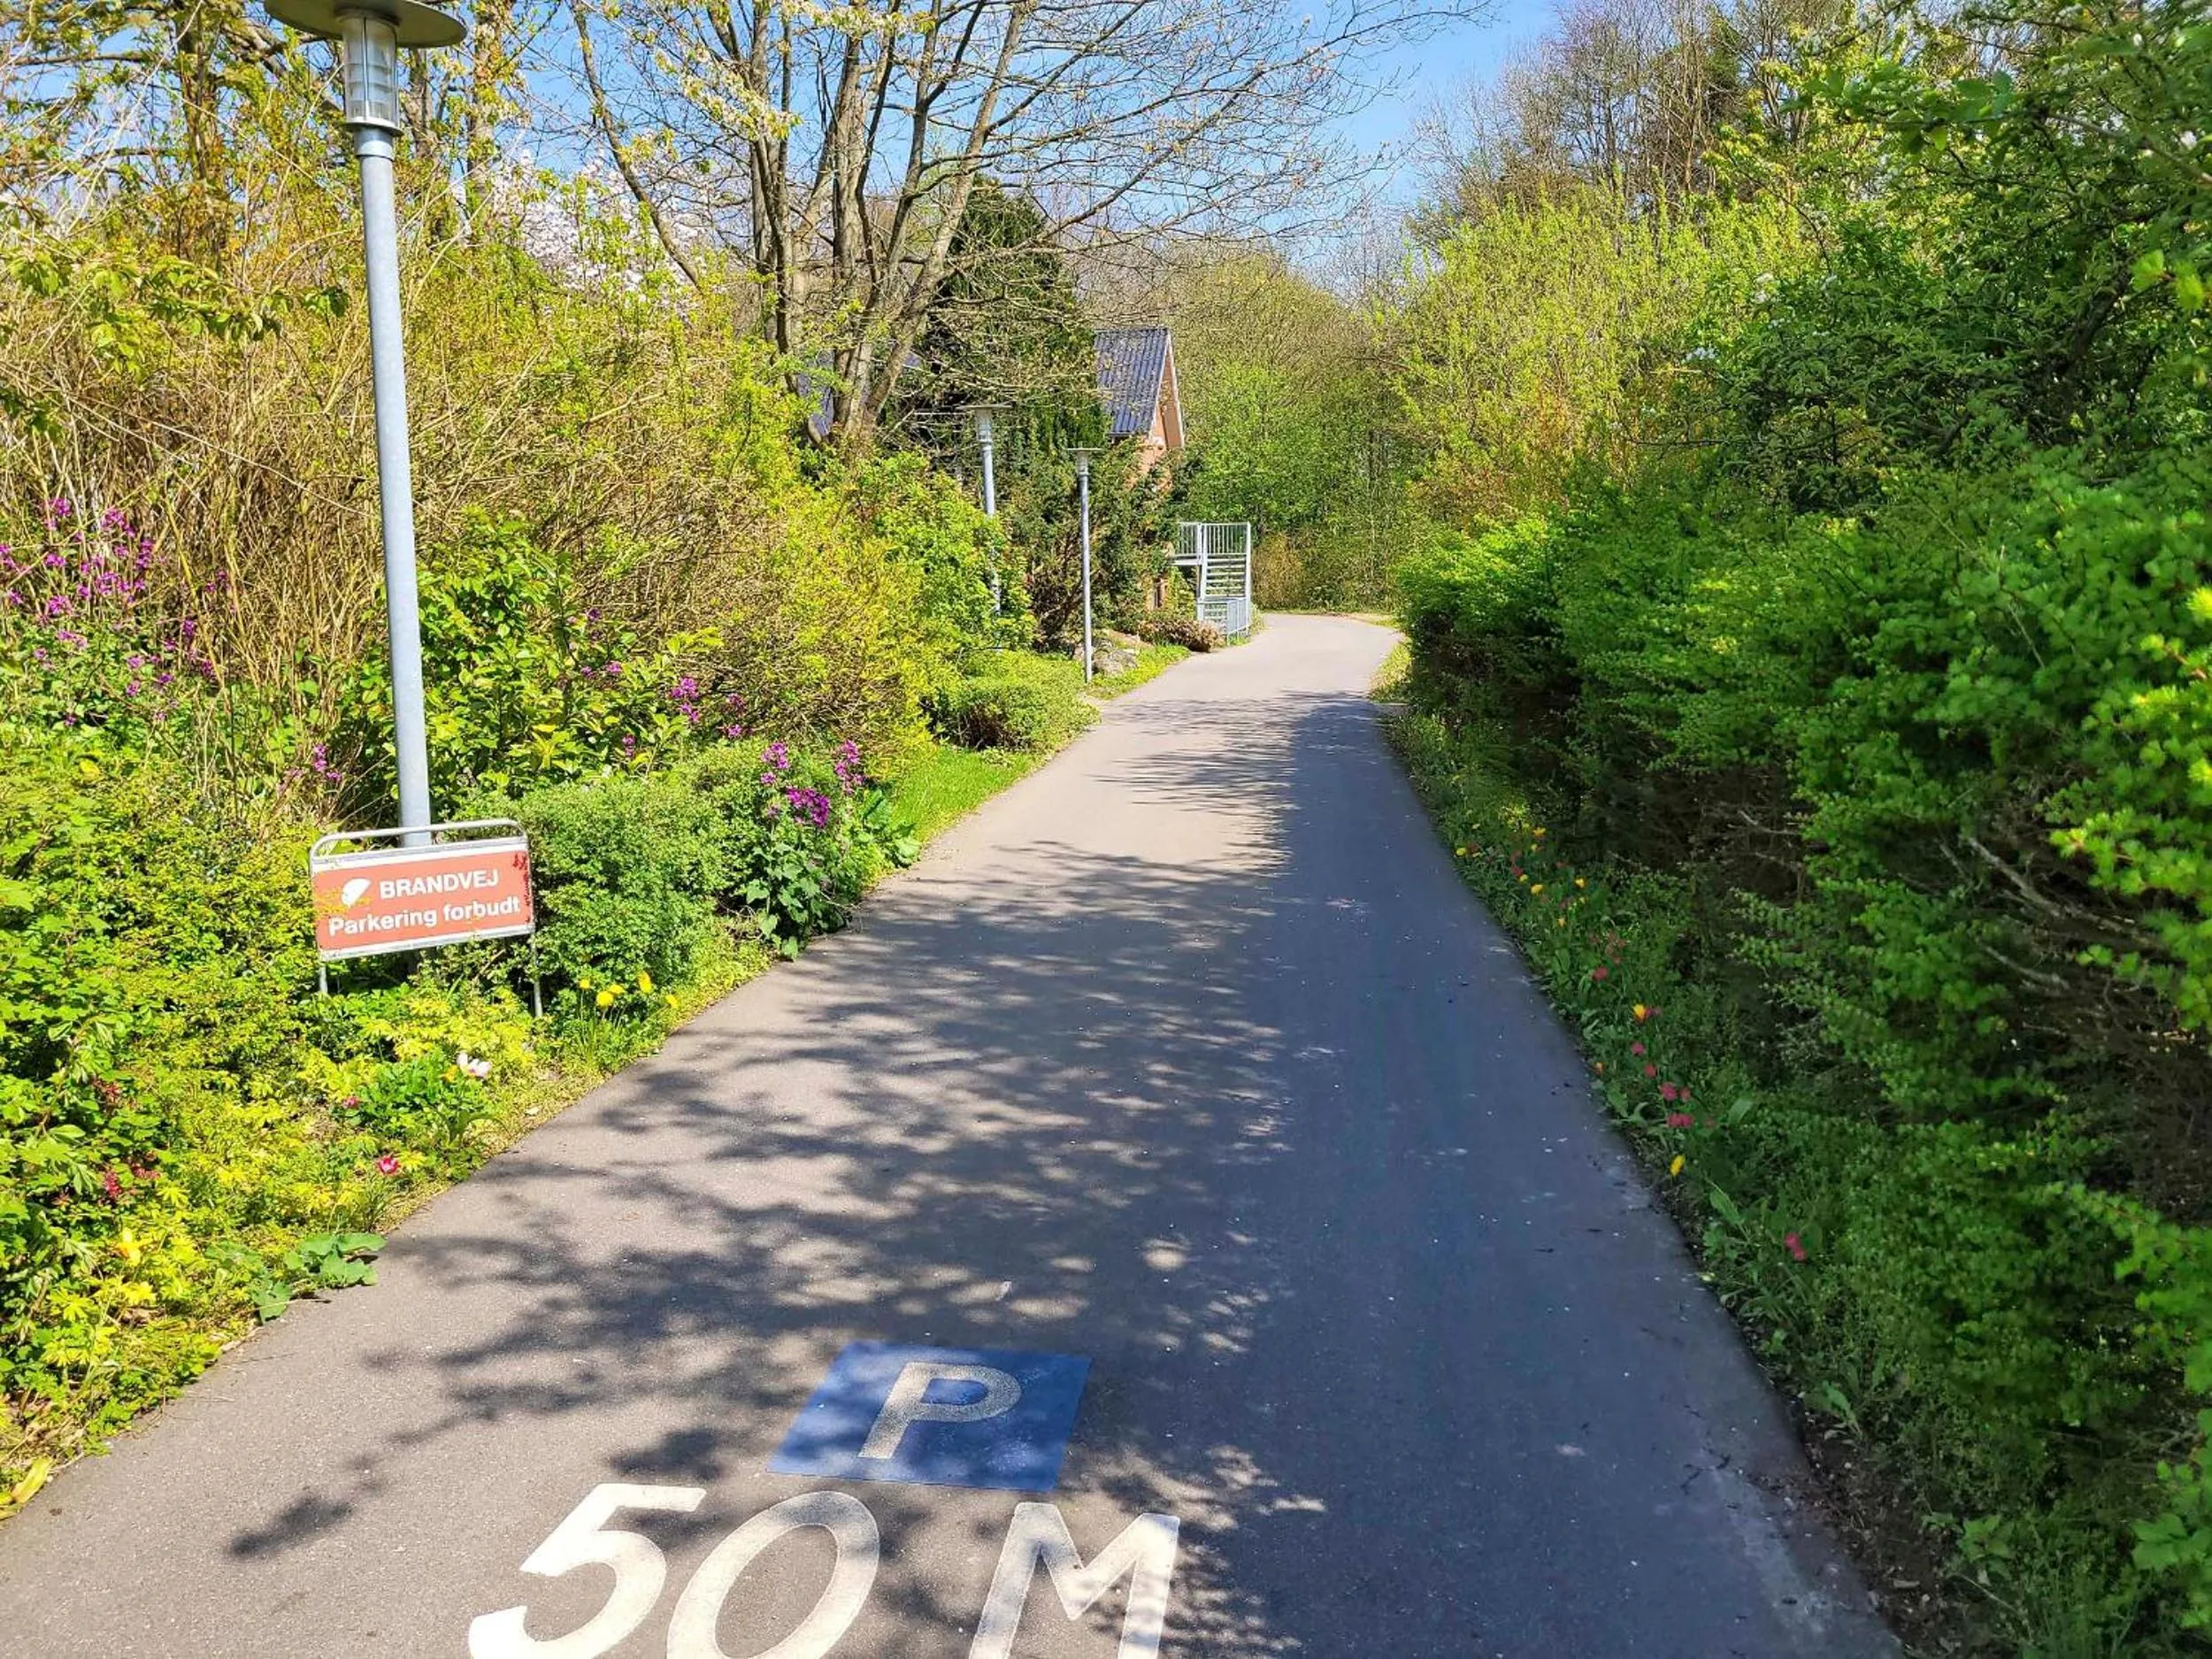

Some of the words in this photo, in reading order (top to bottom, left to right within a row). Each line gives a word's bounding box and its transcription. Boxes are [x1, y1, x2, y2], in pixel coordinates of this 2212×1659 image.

[327, 907, 438, 936] Parkering
[443, 895, 521, 922] forbudt
[379, 869, 500, 900] BRANDVEJ
[857, 1362, 1021, 1459] P
[468, 1482, 880, 1659] 50
[968, 1502, 1180, 1659] M
